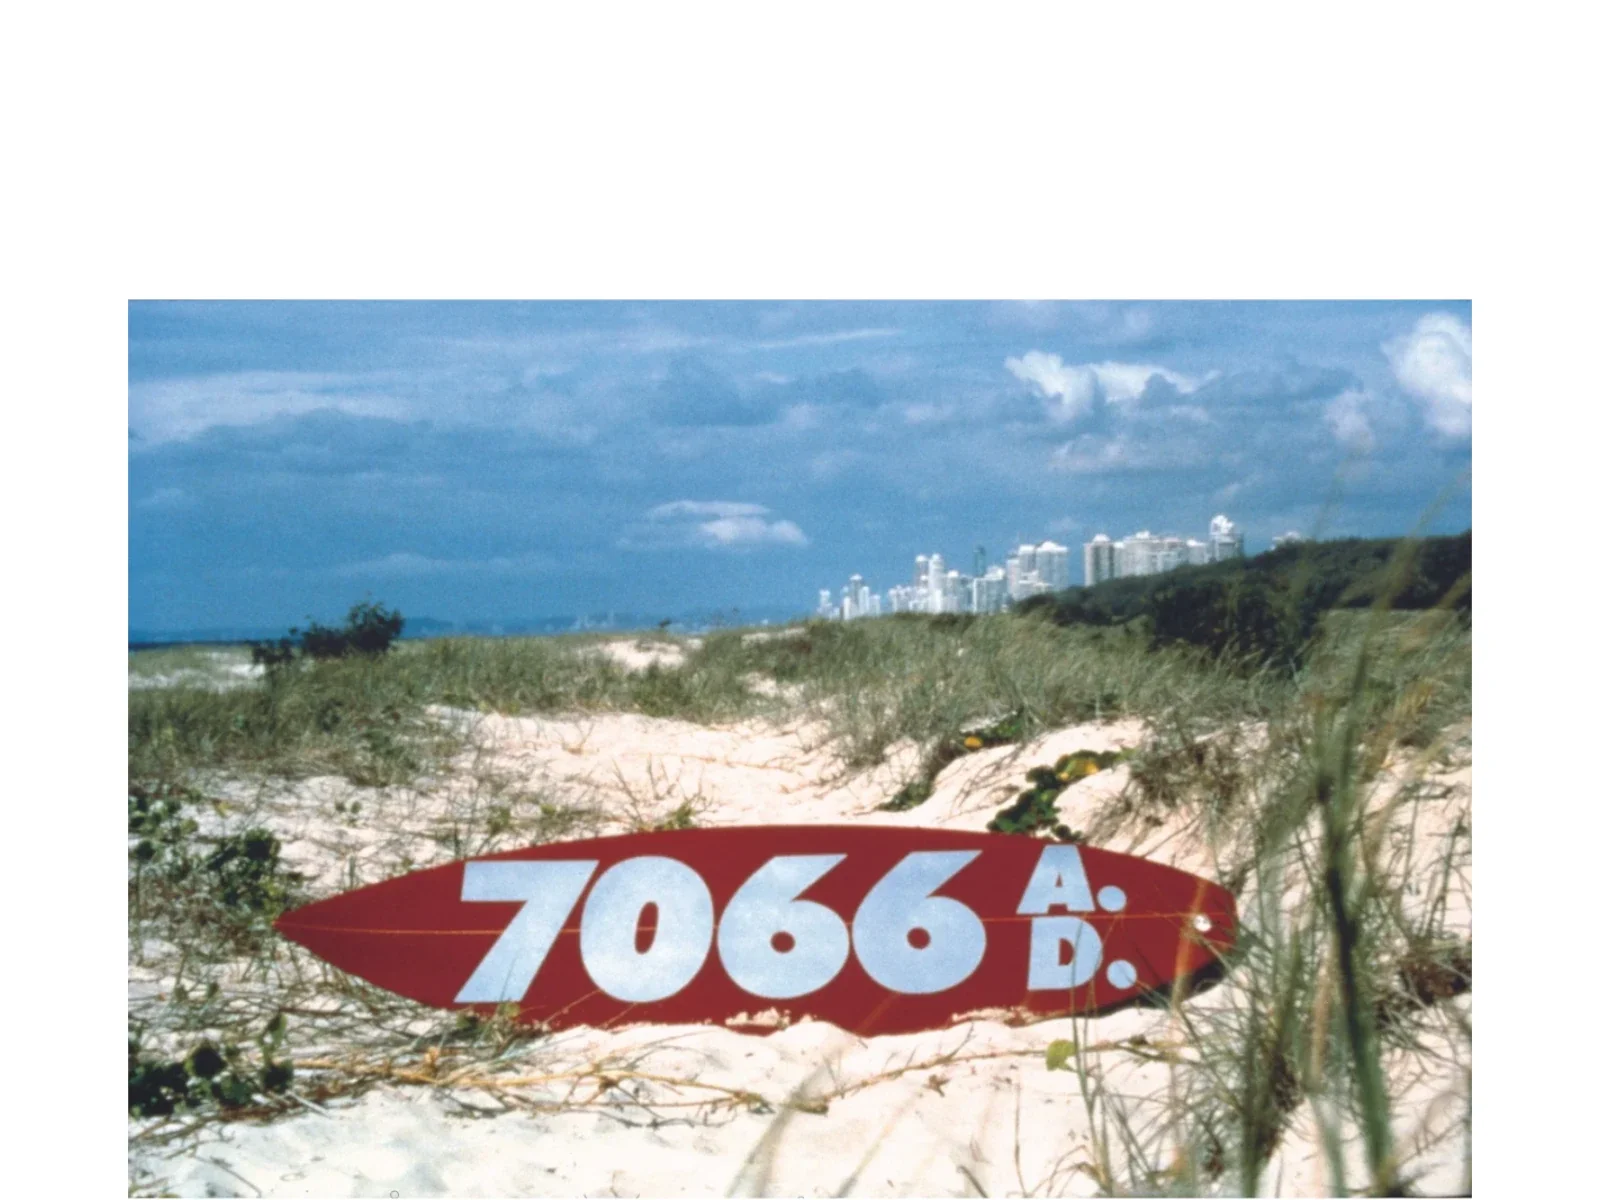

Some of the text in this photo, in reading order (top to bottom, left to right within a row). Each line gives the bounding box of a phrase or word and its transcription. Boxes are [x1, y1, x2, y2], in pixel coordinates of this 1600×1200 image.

[1017, 843, 1127, 914] A.
[455, 849, 987, 1003] 7066
[1027, 916, 1137, 991] D.
